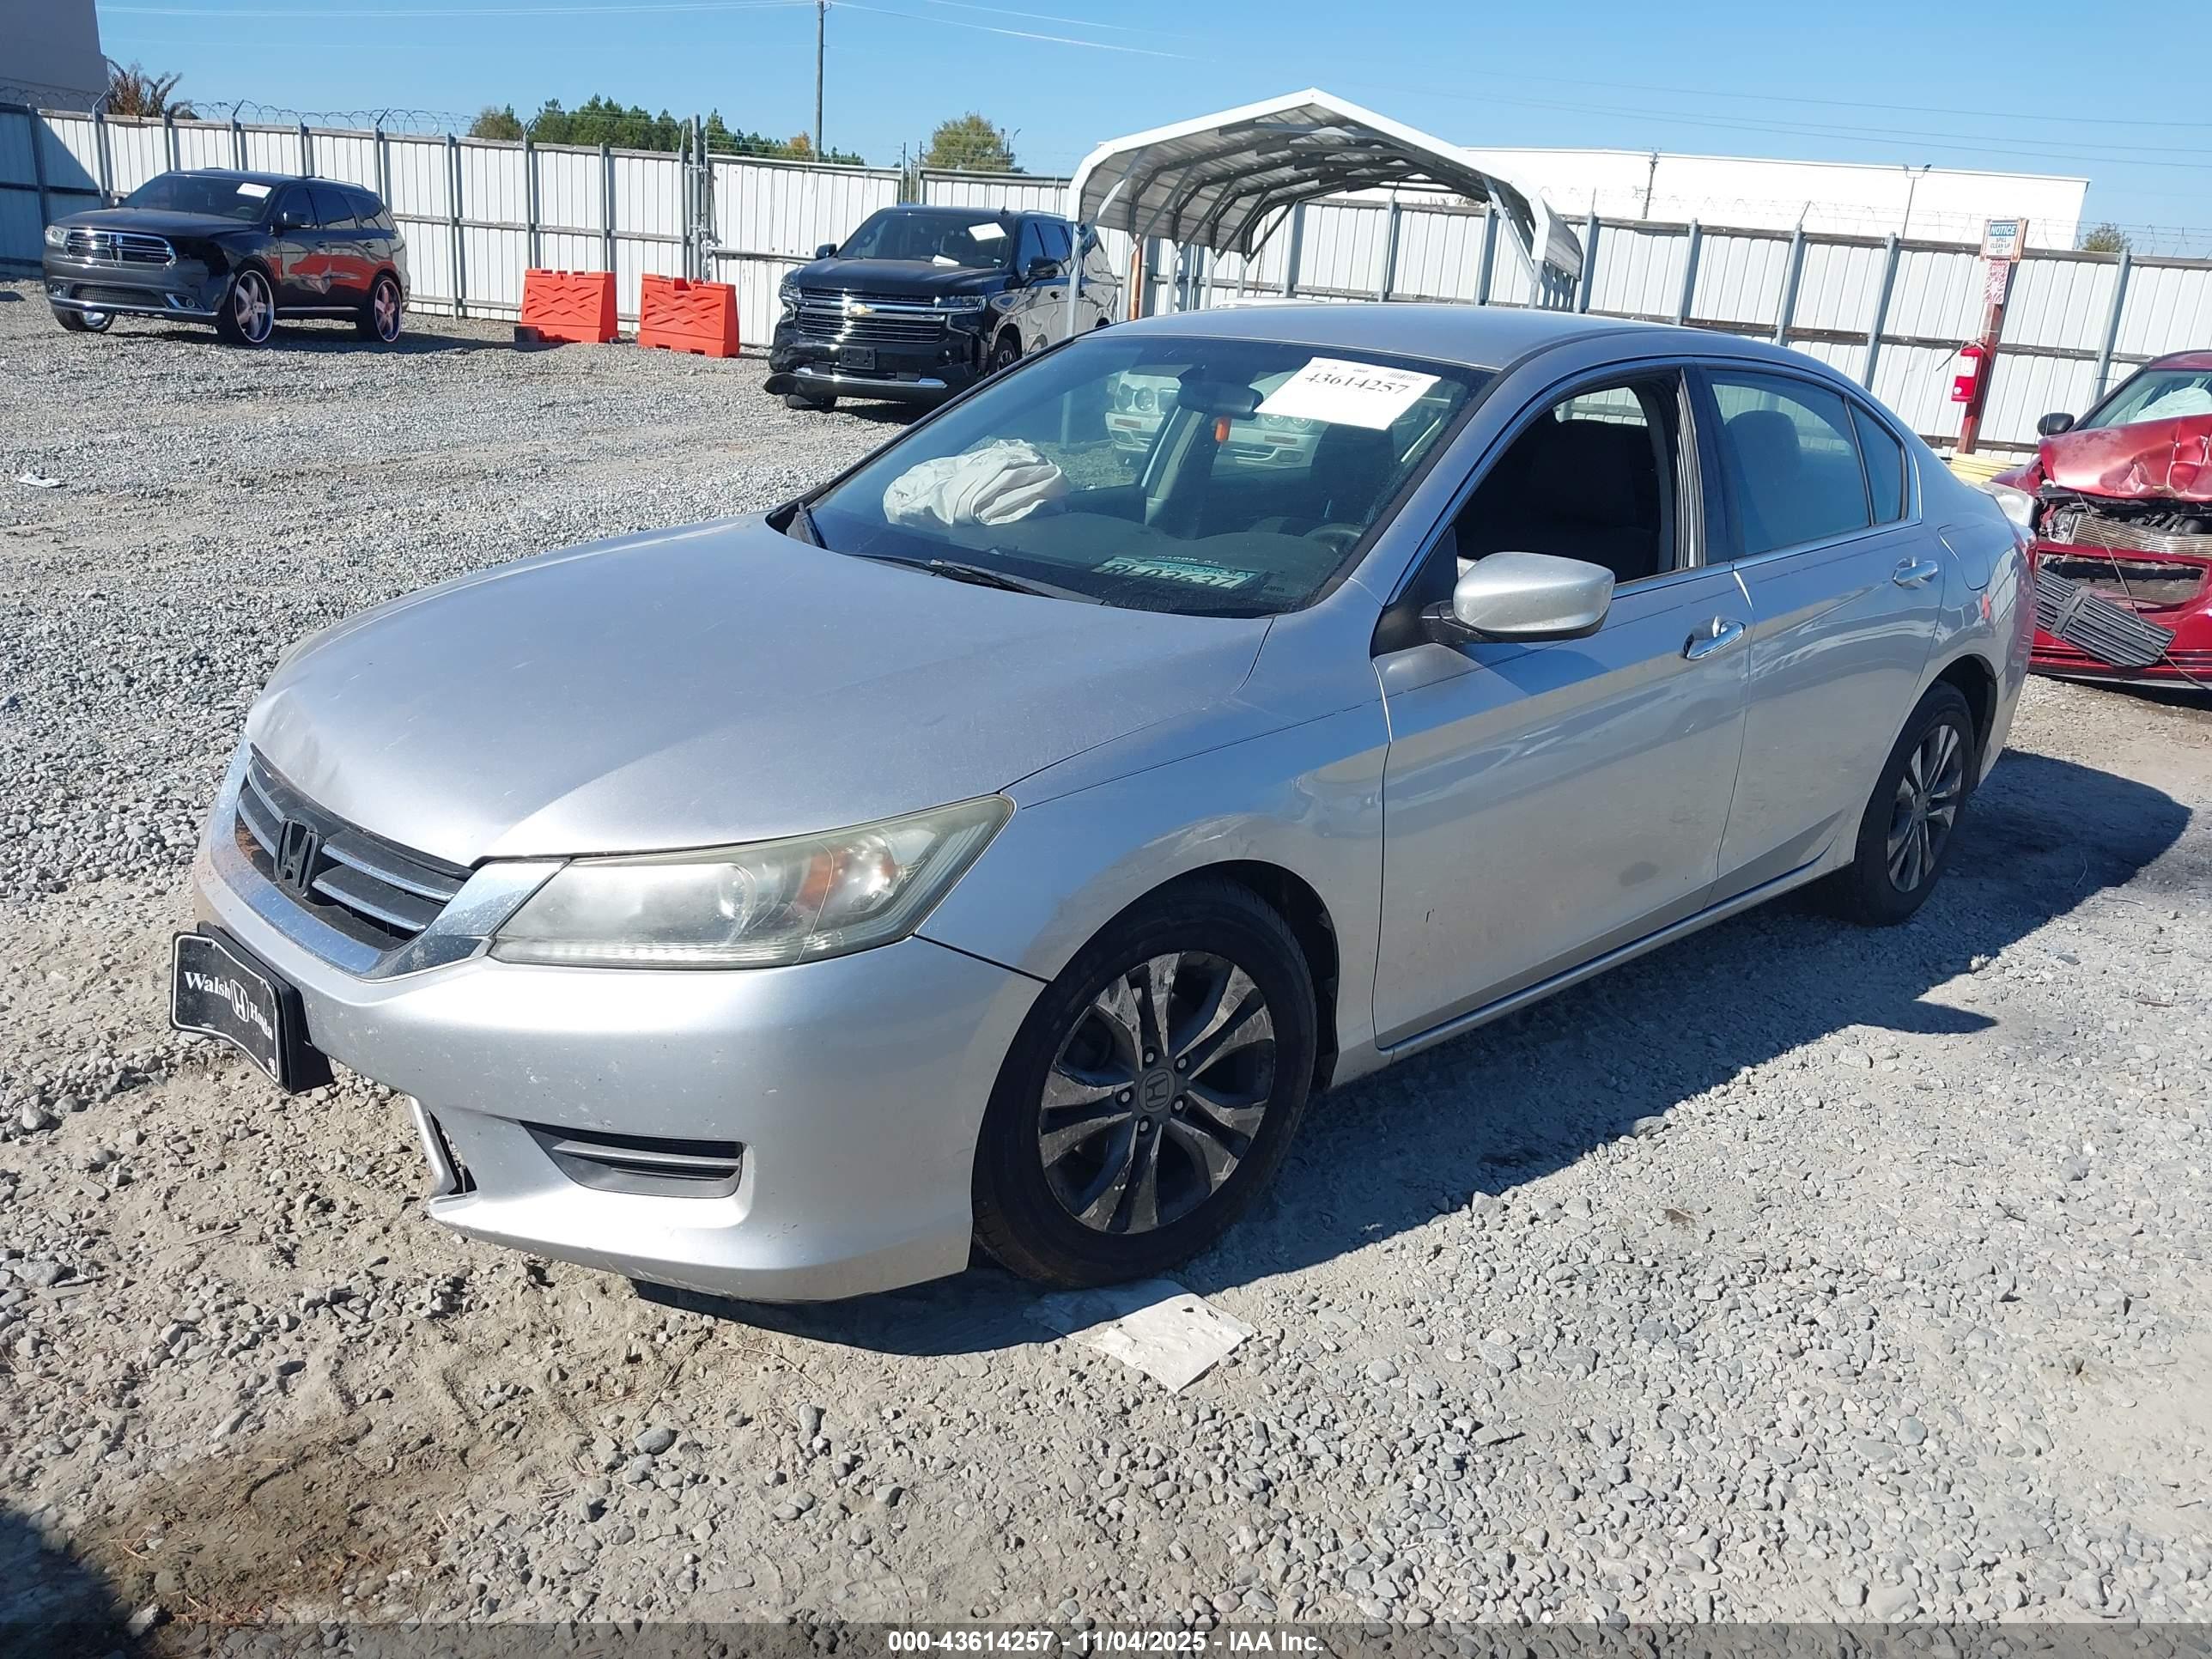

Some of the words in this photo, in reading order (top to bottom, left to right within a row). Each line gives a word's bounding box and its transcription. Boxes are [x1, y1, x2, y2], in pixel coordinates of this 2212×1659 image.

[1990, 225, 2016, 235] NOTICE
[1305, 372, 1411, 395] 43614257
[1166, 563, 1250, 579] GEORGIA
[184, 971, 232, 1000] Walsh
[249, 1000, 273, 1041] Honda
